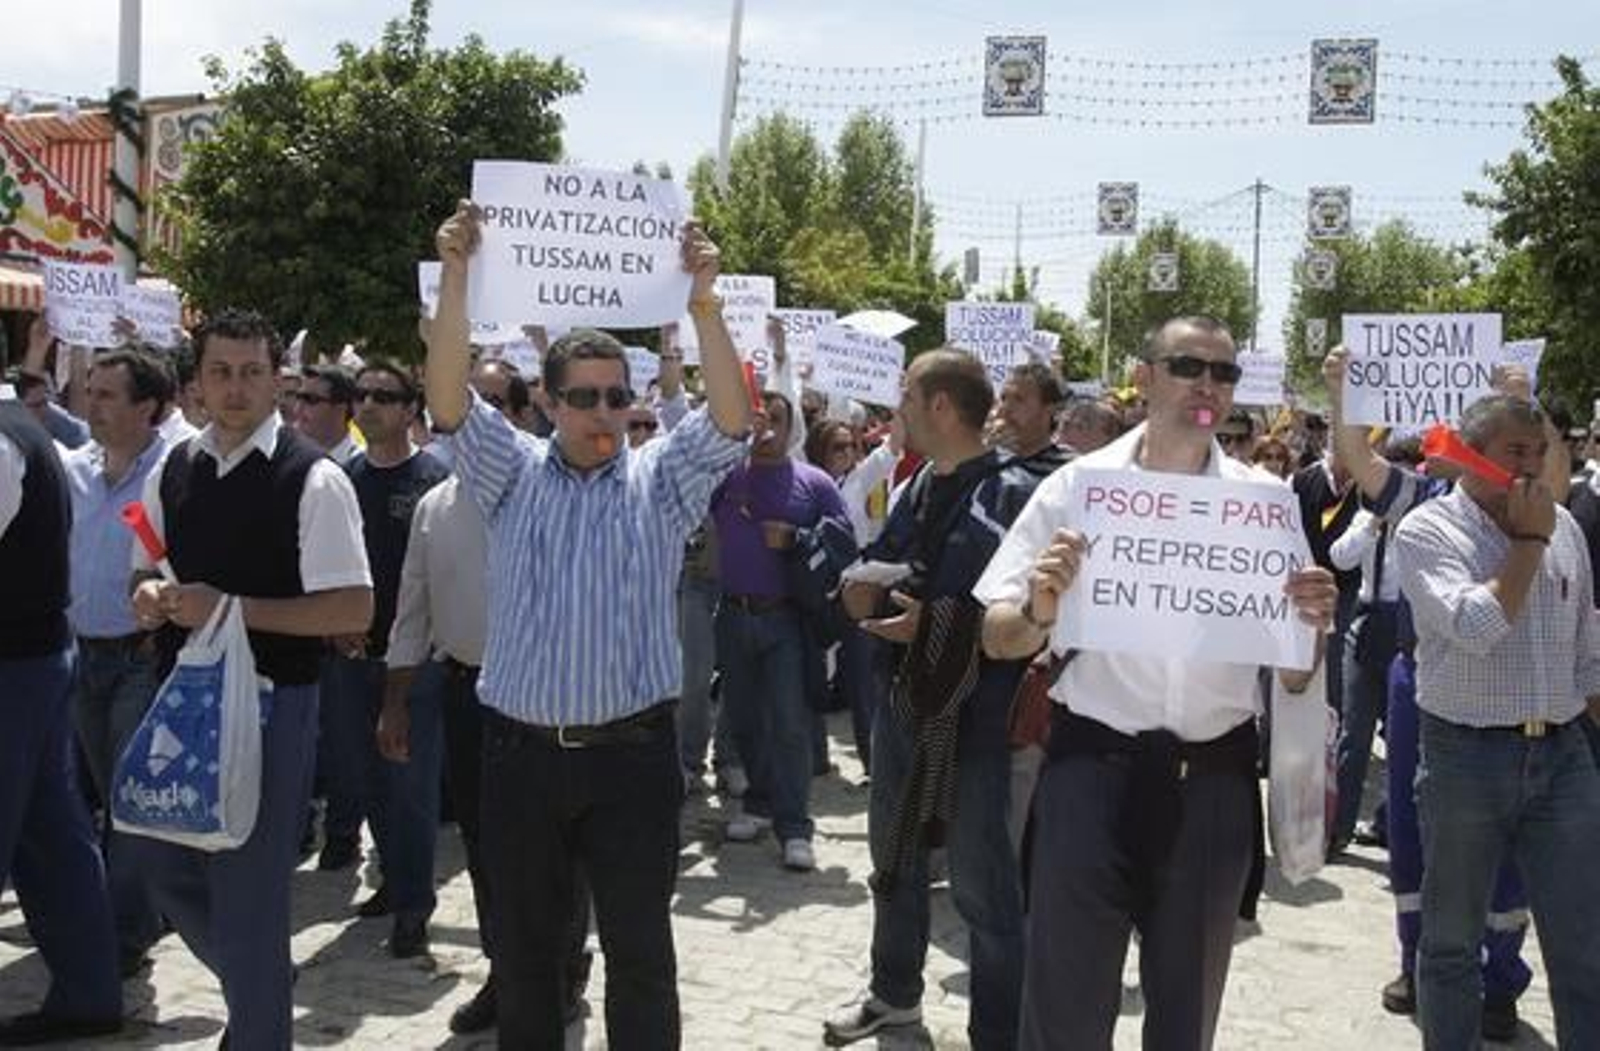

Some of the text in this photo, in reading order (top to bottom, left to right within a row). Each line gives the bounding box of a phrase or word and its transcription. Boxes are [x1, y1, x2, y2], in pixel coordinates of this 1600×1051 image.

[544, 175, 648, 203] NO A LA
[511, 244, 653, 274] TUSSAM EN
[538, 283, 623, 309] LUCHA
[959, 306, 1023, 326] TUSSAM
[951, 327, 1031, 343] SOLUCION
[1362, 323, 1475, 357] TUSSAM
[1349, 360, 1496, 389] SOLUCION
[1084, 487, 1179, 520] PSOE
[1081, 533, 1306, 578] Y REPRESION
[1092, 578, 1289, 621] EN TUSSAM
